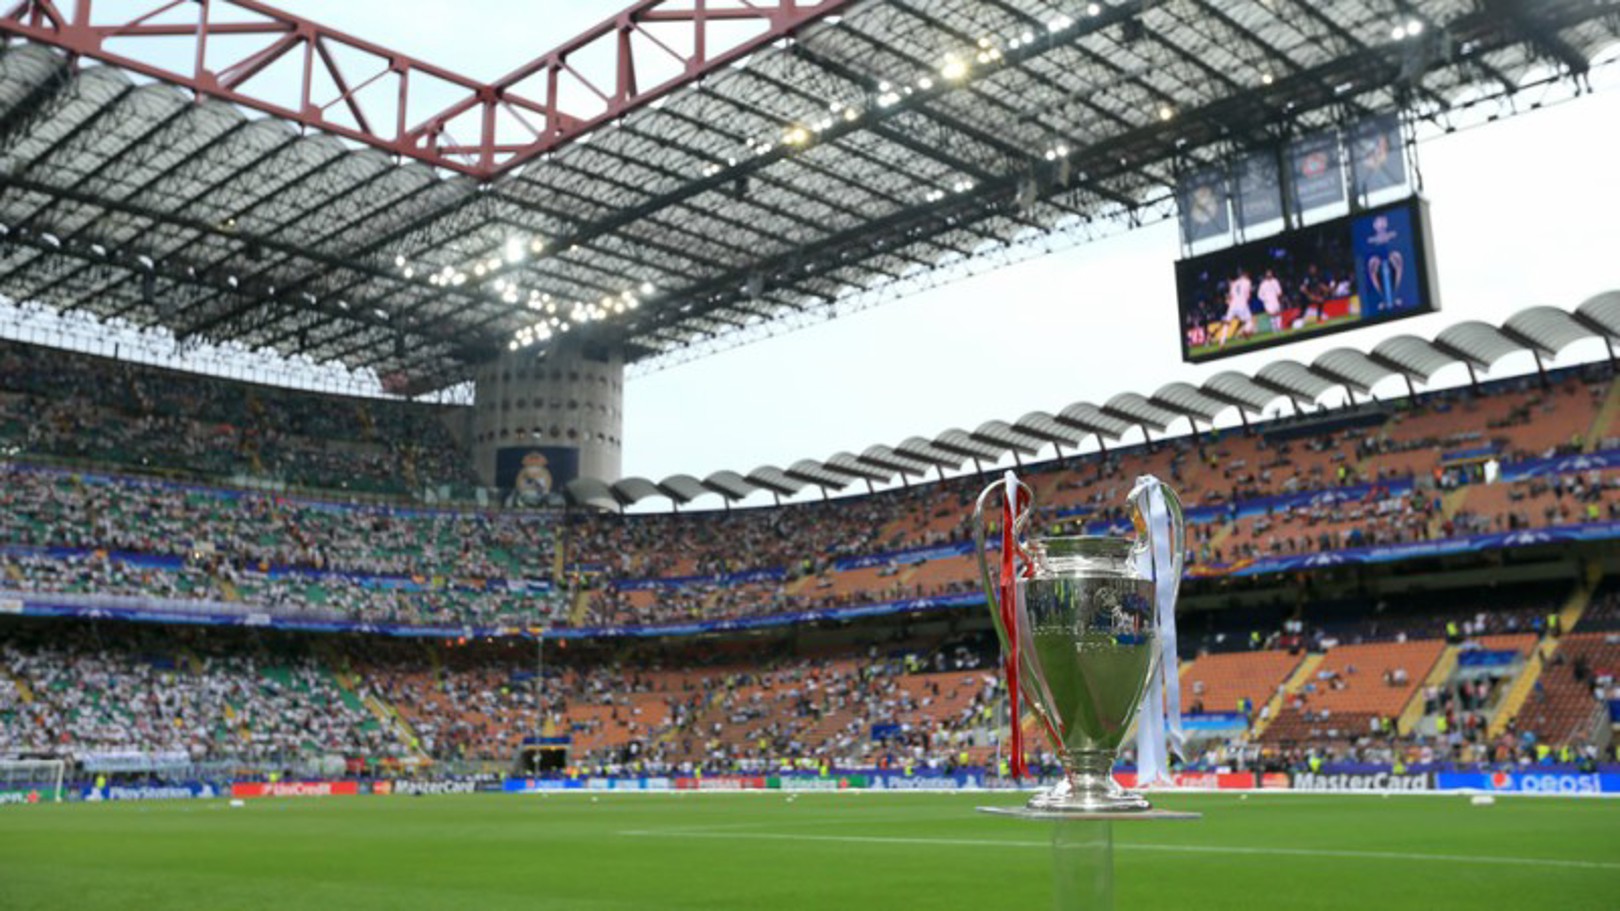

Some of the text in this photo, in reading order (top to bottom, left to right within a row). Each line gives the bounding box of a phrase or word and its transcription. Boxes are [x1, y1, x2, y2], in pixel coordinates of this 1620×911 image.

[395, 779, 476, 794] MasterCard
[1294, 772, 1428, 790] MasterCard
[110, 786, 191, 800] PlayStation
